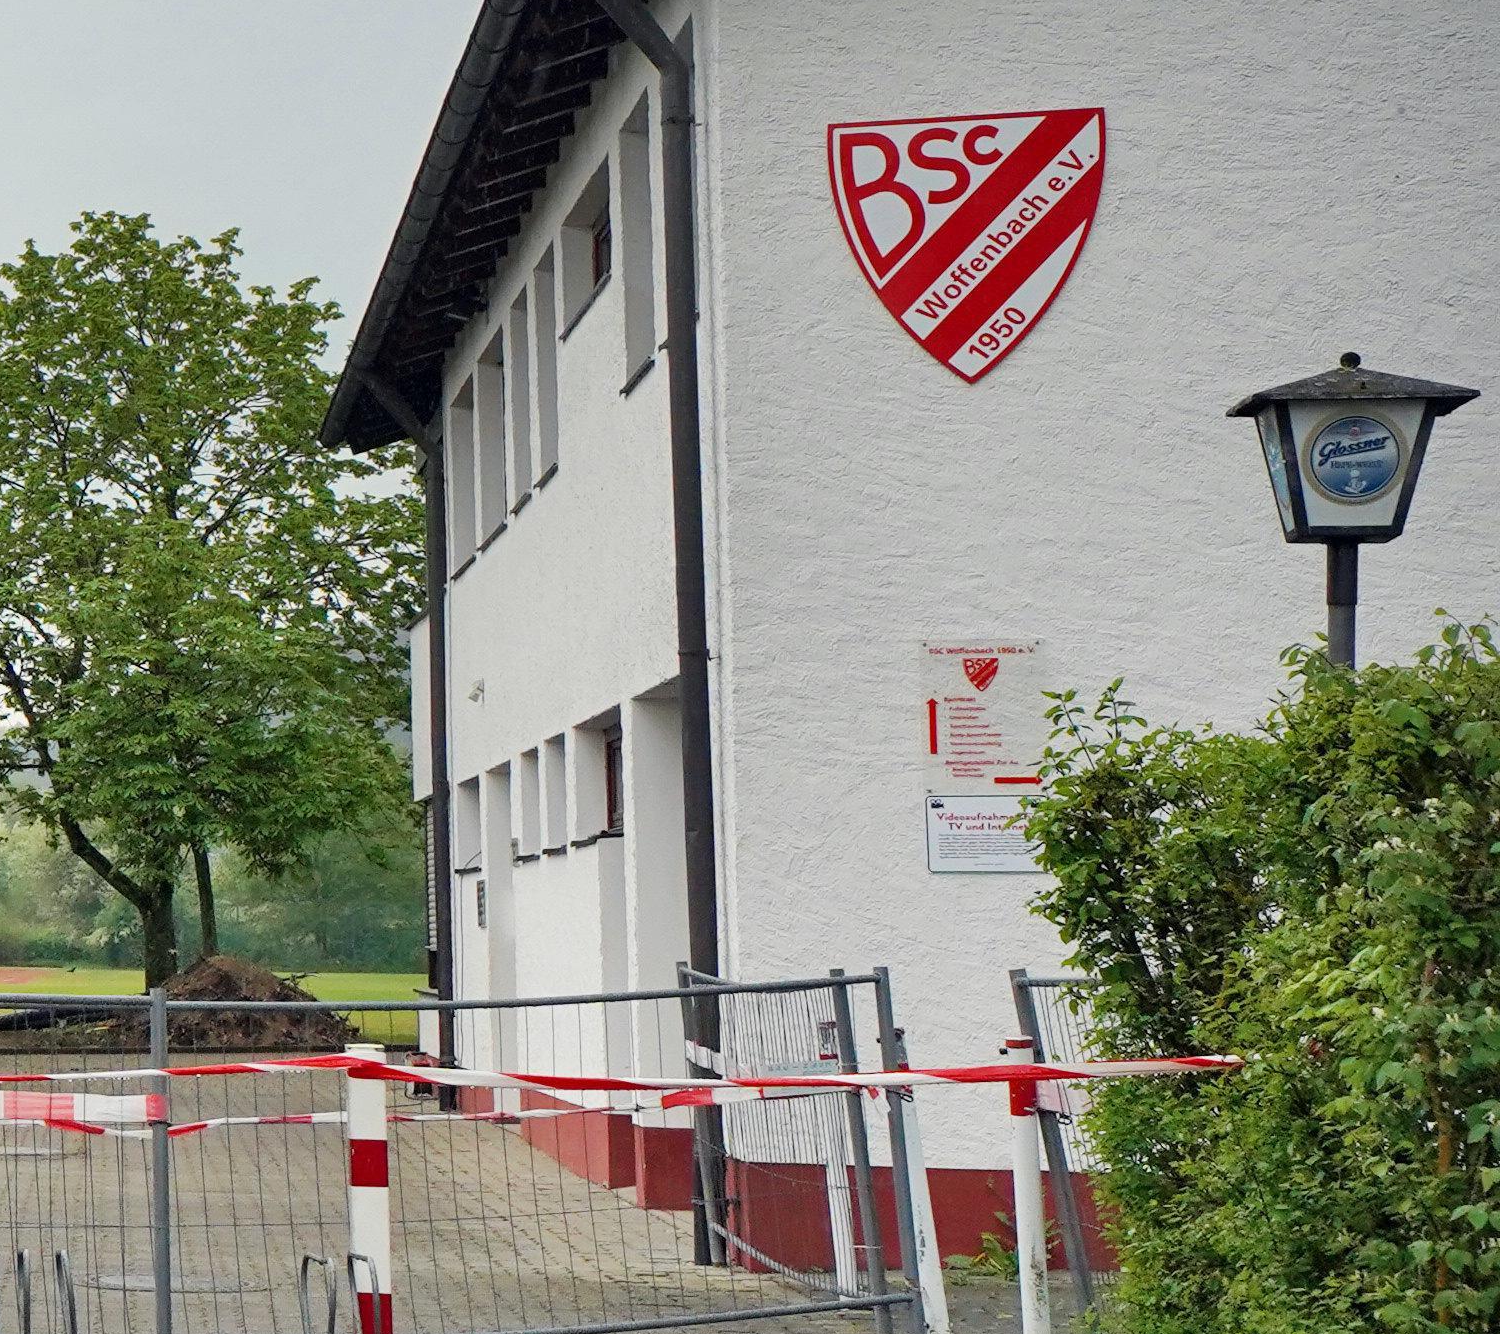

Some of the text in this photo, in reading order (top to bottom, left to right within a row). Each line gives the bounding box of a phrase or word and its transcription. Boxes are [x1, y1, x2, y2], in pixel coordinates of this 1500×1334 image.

[839, 125, 1003, 281] BSC
[915, 193, 1050, 321] Woffenbach
[968, 306, 1027, 361] 1950
[936, 812, 1015, 821] Videoaufnahm
[948, 822, 1030, 832] TV und Intnet
